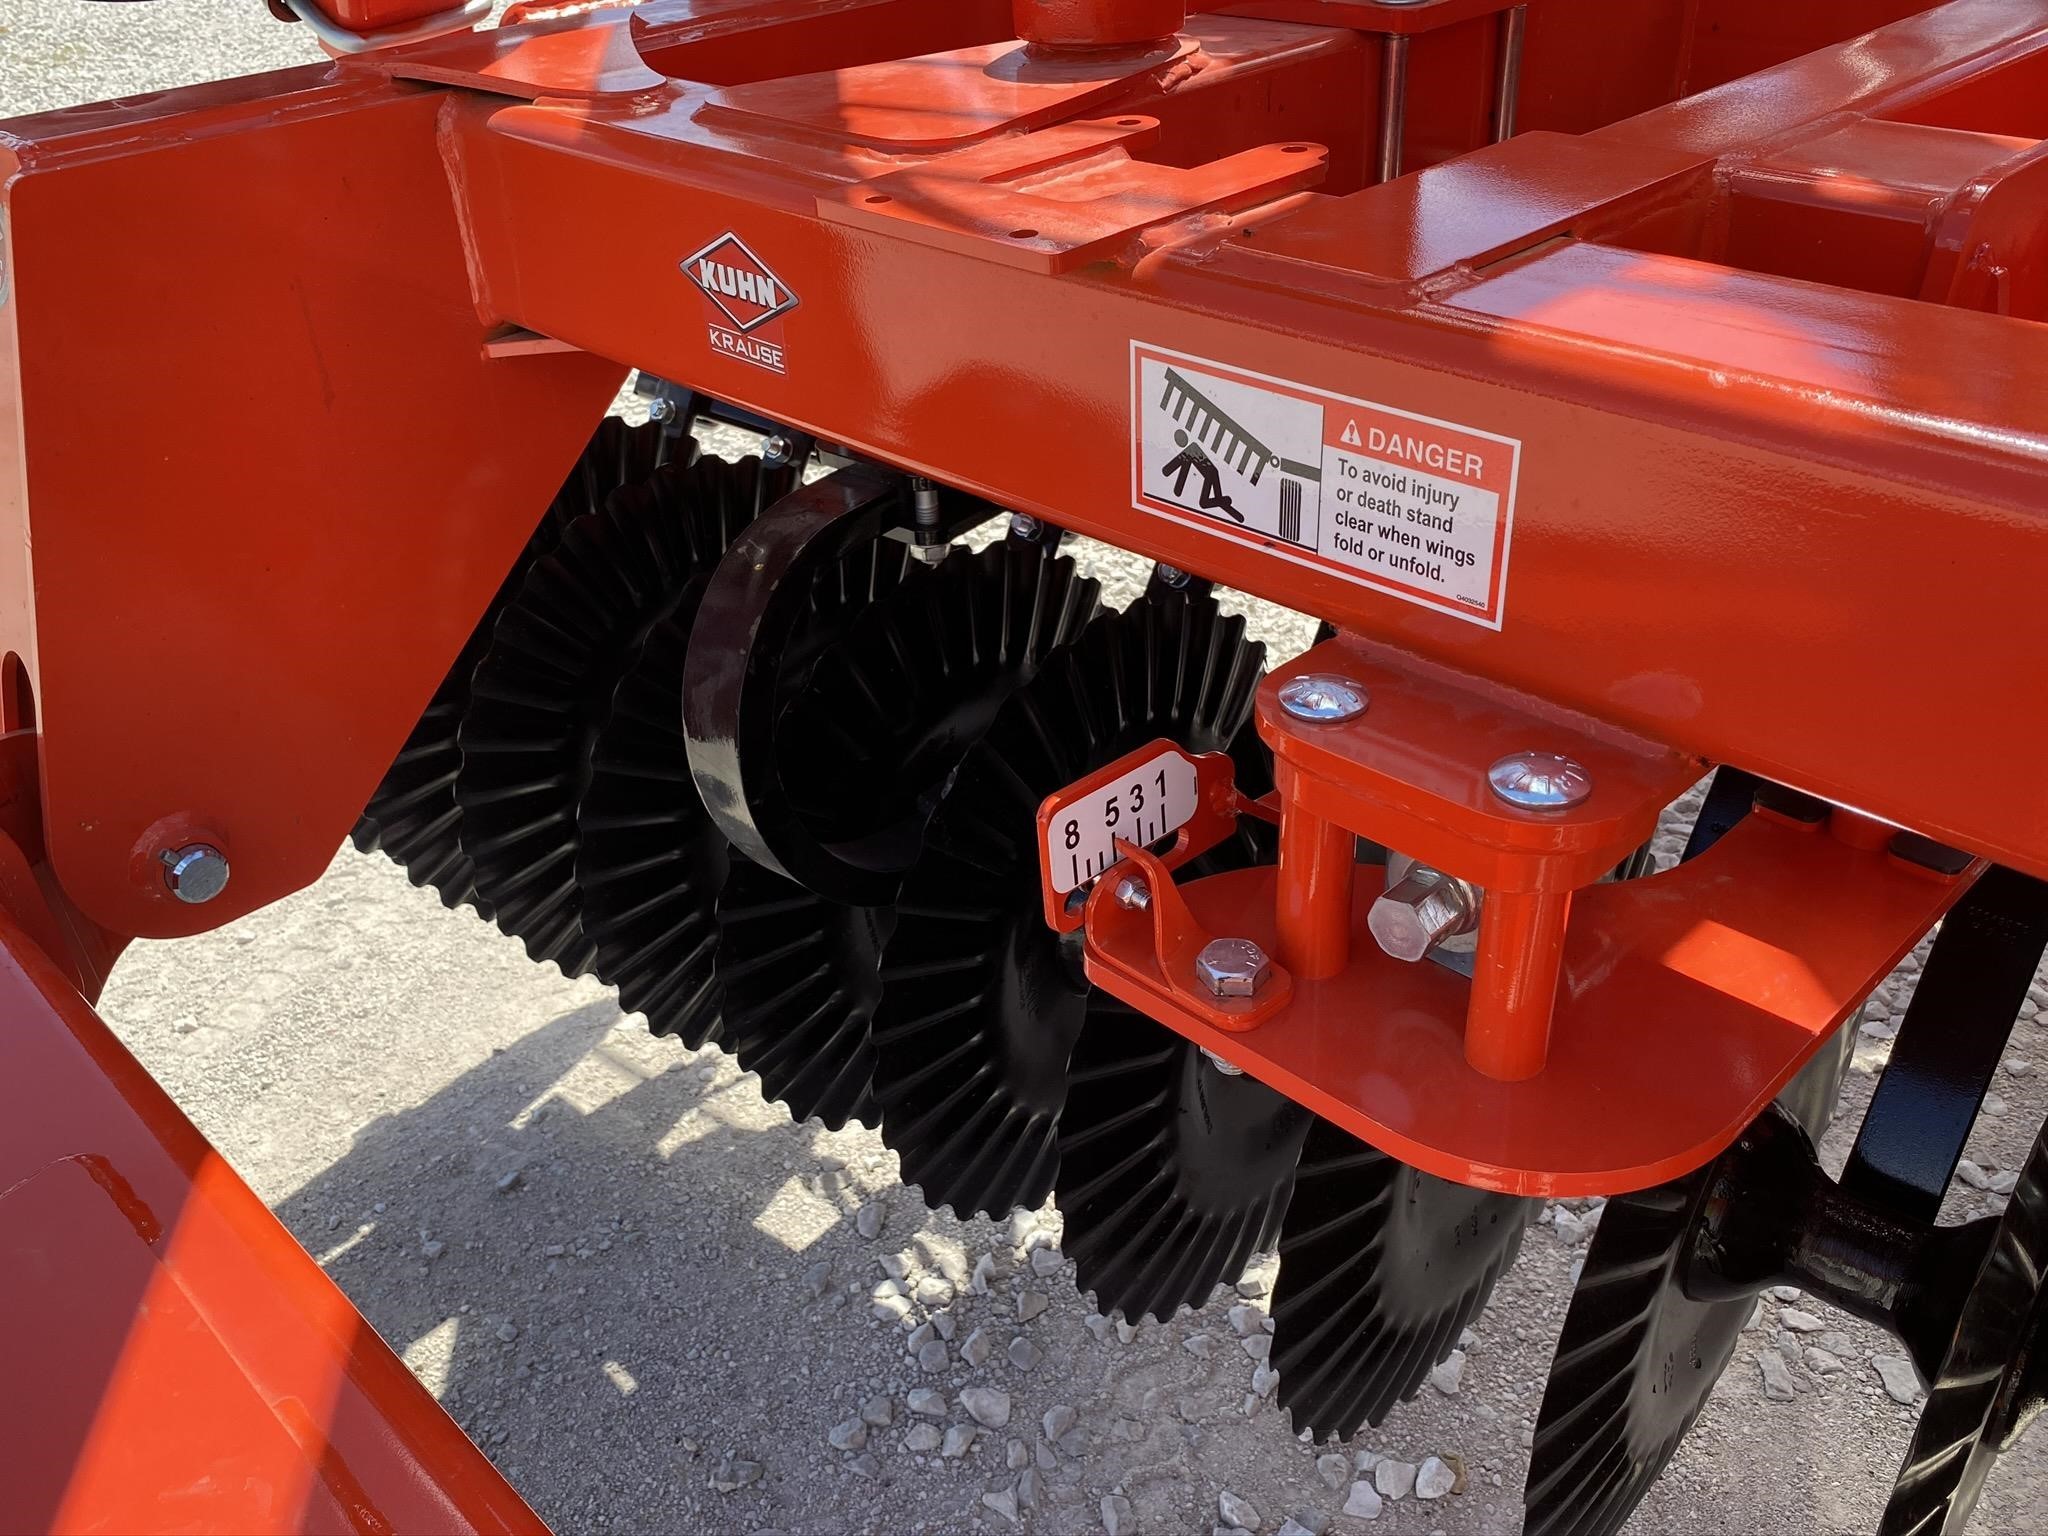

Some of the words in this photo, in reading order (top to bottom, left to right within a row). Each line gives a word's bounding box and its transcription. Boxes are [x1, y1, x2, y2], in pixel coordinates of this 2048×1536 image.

[699, 258, 777, 310] KUHN
[709, 328, 785, 369] KRAUSE
[1368, 427, 1484, 480] DANGER
[1336, 488, 1353, 501] or
[1357, 491, 1401, 518] death
[1406, 507, 1454, 534] stand
[1337, 458, 1358, 479] To
[1362, 469, 1407, 494] avoid
[1411, 480, 1460, 512] injury
[1333, 532, 1364, 557] fold
[1368, 547, 1385, 562] or
[1389, 554, 1446, 583] unfold.
[1335, 510, 1374, 534] clear
[1377, 523, 1421, 549] when
[1425, 538, 1476, 568] wings
[1064, 819, 1081, 850] 8
[1105, 796, 1120, 827] 5
[1129, 783, 1145, 813] 3
[1154, 769, 1166, 797] 1
